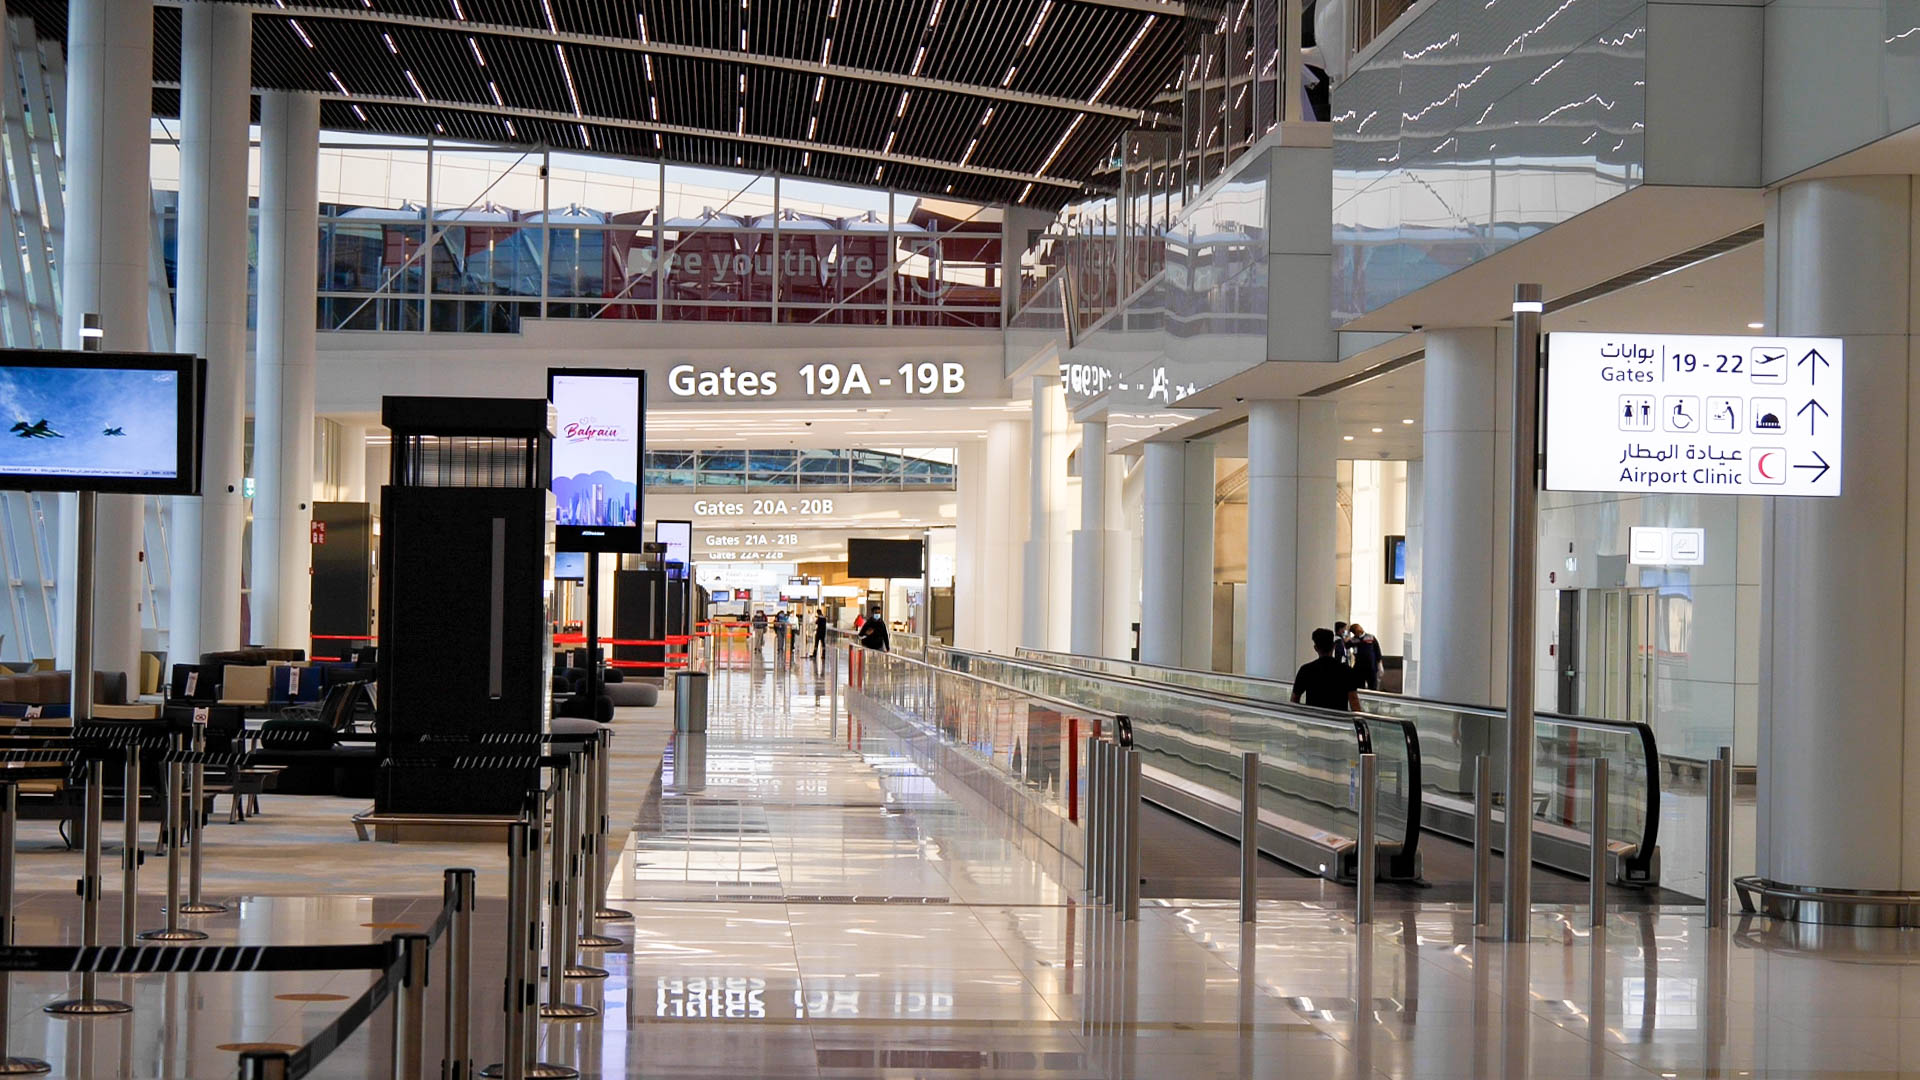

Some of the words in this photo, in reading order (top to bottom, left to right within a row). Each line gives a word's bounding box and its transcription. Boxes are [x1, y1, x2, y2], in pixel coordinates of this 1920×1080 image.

[712, 252, 772, 281] you
[782, 247, 873, 278] there
[1601, 343, 1655, 364] بوابات
[1672, 353, 1697, 373] 19
[1716, 354, 1743, 374] 22
[668, 365, 777, 397] Gates
[799, 364, 872, 395] 19A
[898, 363, 965, 394] 19B
[1601, 366, 1654, 383] Gates
[563, 422, 617, 440] Bahrain
[1619, 443, 1678, 464] المطار
[1686, 444, 1743, 465] عيادة
[1619, 467, 1688, 487] Airport
[1693, 468, 1742, 485] Clinic
[694, 501, 744, 516] Gates
[753, 500, 789, 515] 20A
[800, 500, 833, 515] 20B
[706, 535, 740, 546] Gates
[745, 535, 768, 546] 21A
[777, 534, 798, 545] 21B
